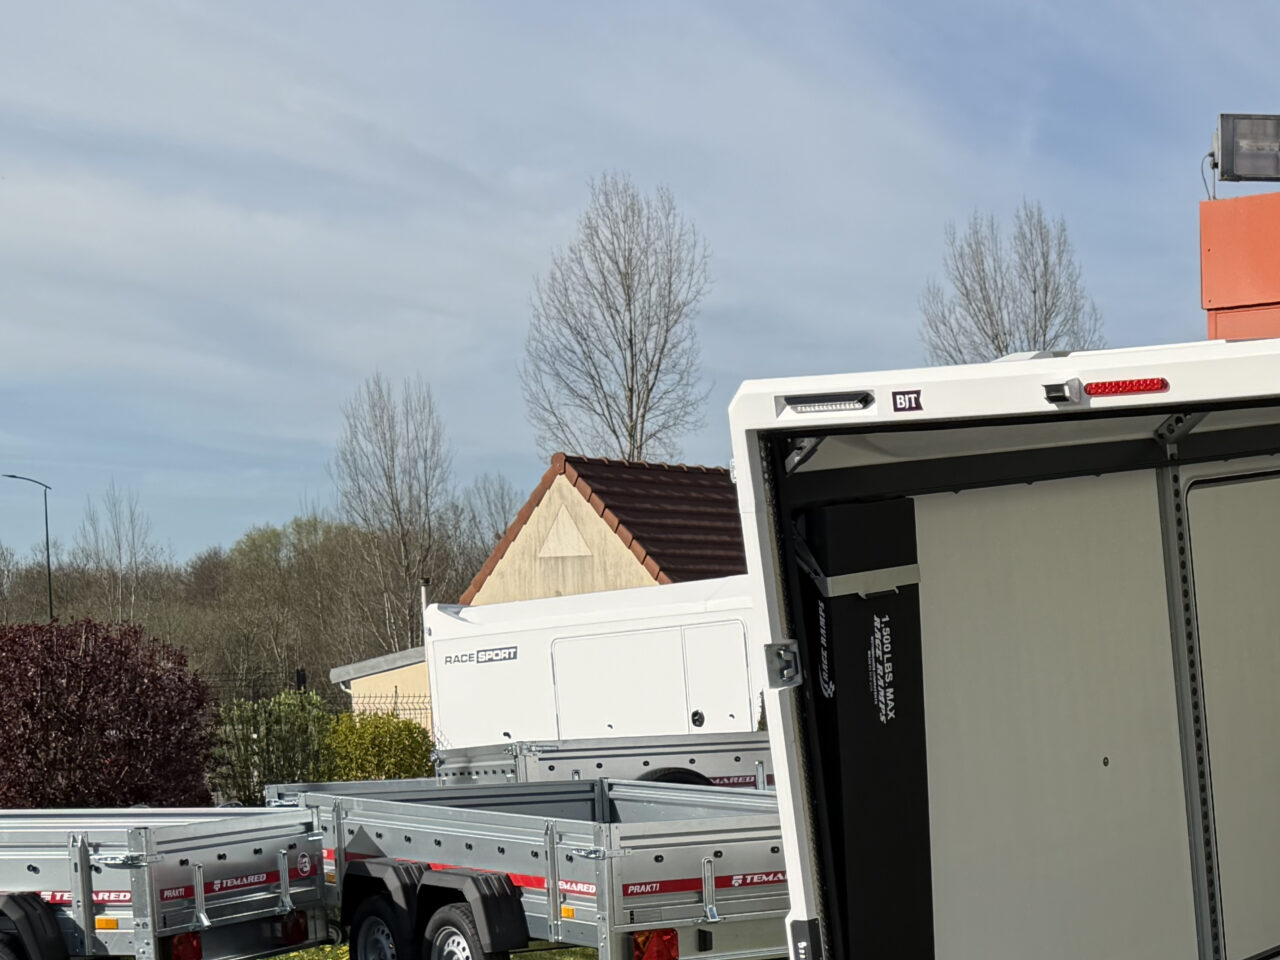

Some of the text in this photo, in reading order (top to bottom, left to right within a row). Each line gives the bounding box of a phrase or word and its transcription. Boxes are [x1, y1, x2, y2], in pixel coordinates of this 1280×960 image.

[895, 393, 918, 409] BJT
[873, 614, 883, 661] RACE
[444, 647, 517, 665] RACE SPORT
[876, 661, 887, 724] RAMPS
[885, 687, 896, 720] MAX
[222, 873, 267, 888] TEMARED
[627, 883, 660, 894] PRAKTI
[163, 887, 185, 899] PRAKTI
